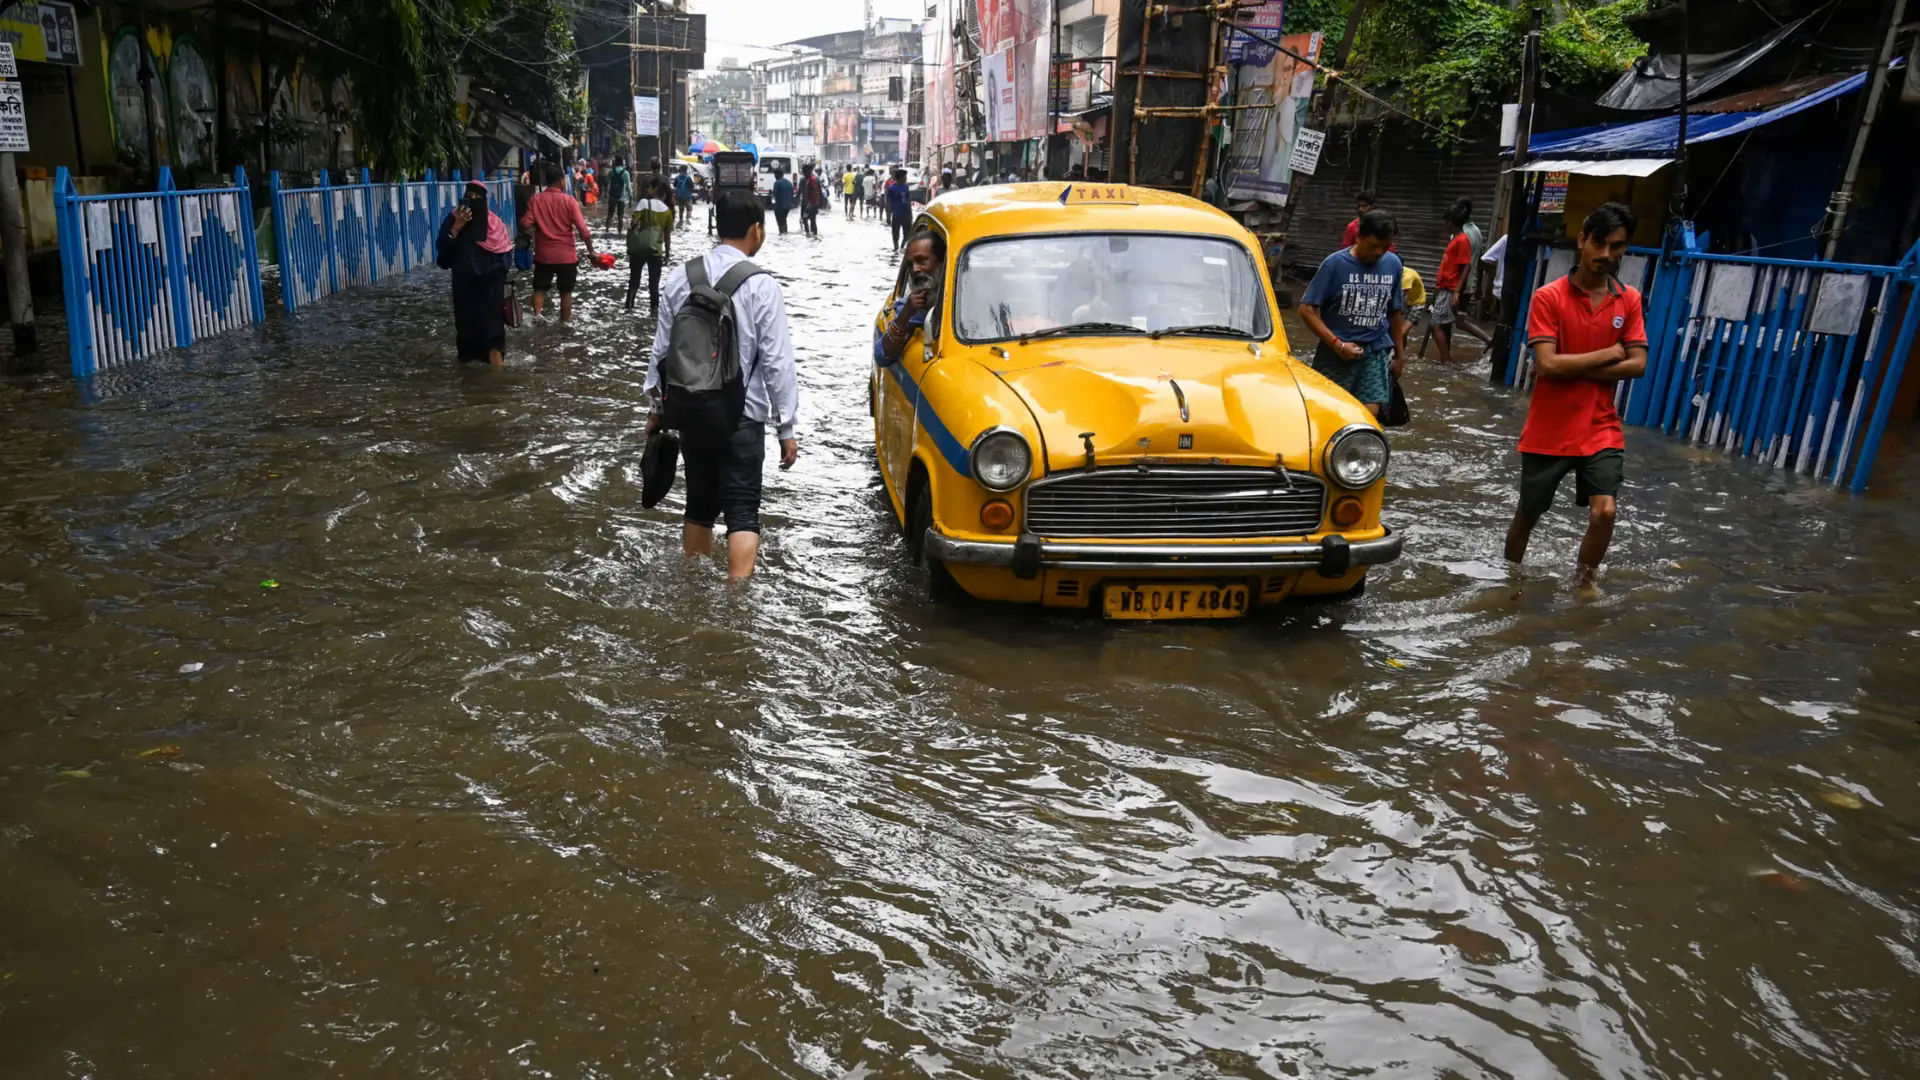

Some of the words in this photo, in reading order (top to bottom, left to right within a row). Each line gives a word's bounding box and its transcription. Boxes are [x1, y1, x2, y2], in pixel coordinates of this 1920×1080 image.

[1261, 15, 1278, 26] CARE
[1297, 139, 1320, 152] চাকরি
[1076, 187, 1125, 199] TAXI
[1363, 273, 1379, 284] POLO
[1179, 436, 1191, 448] HM
[1197, 589, 1245, 611] 4849
